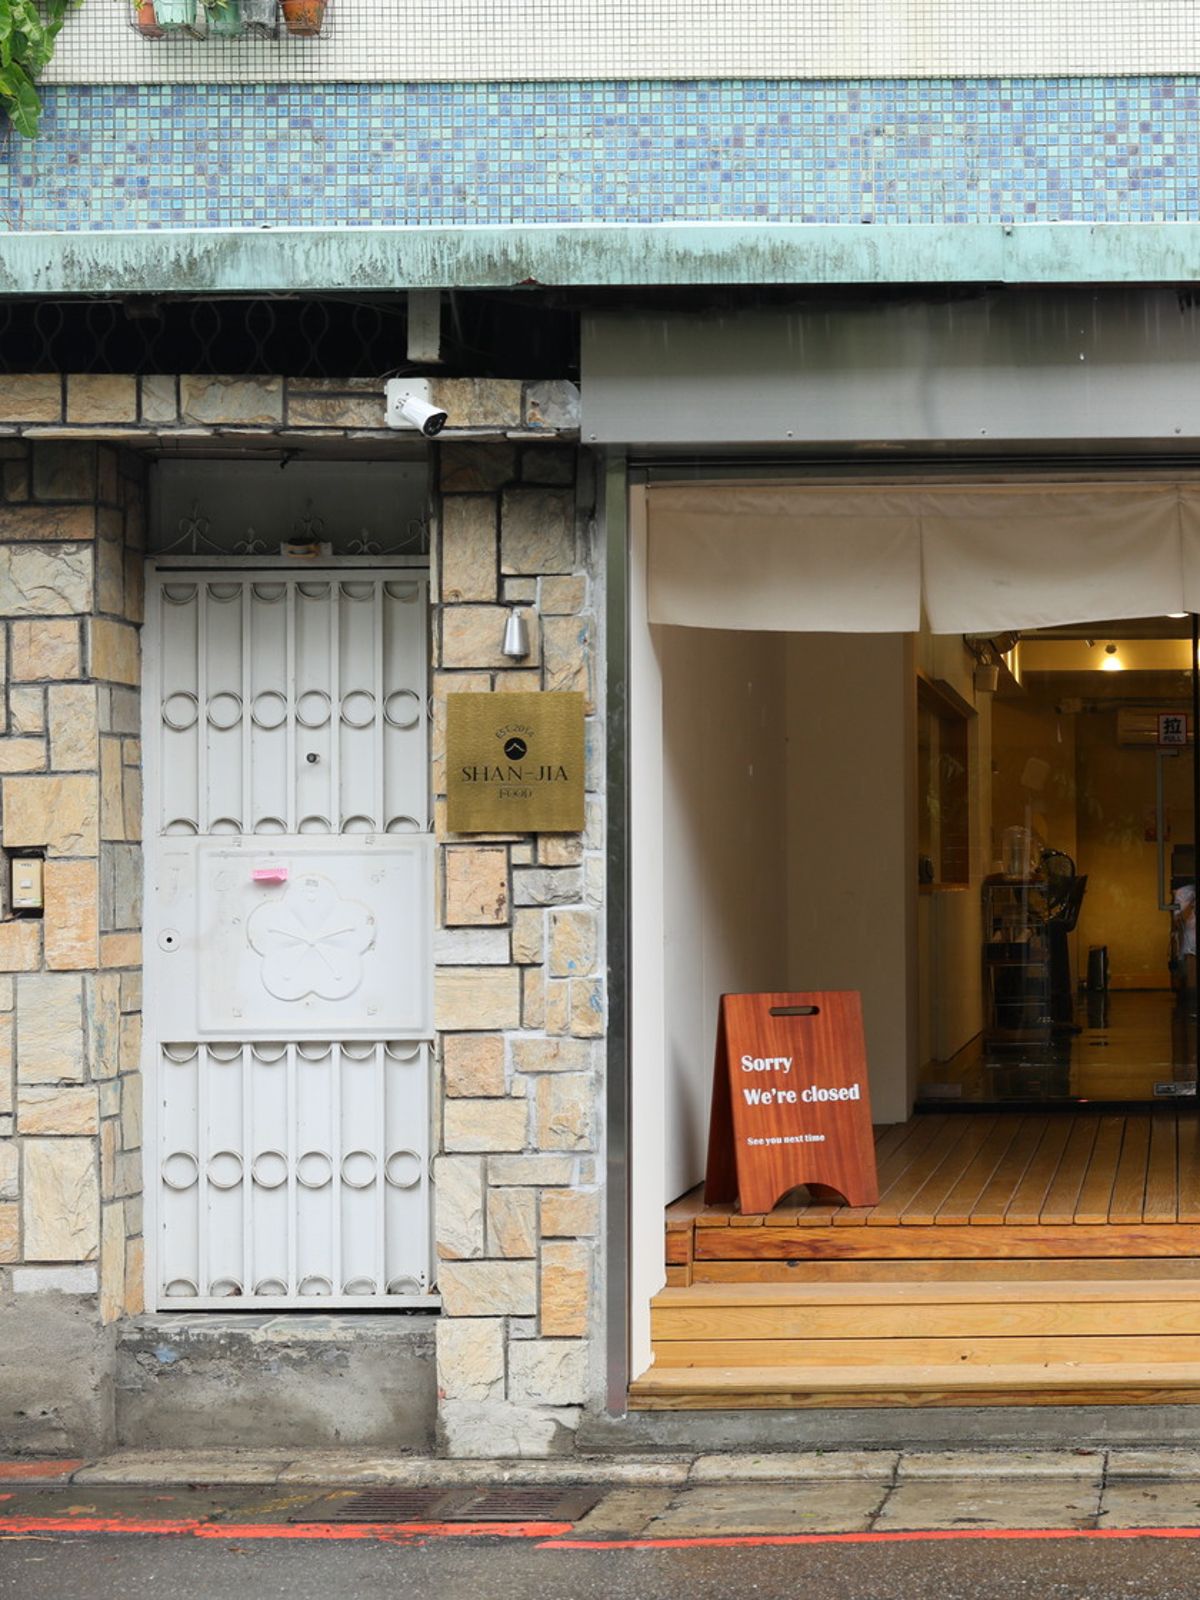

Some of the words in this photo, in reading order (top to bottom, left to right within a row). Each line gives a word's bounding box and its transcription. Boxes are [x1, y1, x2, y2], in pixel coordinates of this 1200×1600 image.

[1163, 717, 1182, 734] 拉
[461, 765, 568, 782] SHAN-JIA
[741, 1055, 793, 1074] Sorry
[743, 1088, 797, 1105] We're
[801, 1083, 860, 1103] closed
[747, 1137, 764, 1146] See
[765, 1136, 782, 1147] you
[783, 1134, 803, 1144] next
[804, 1132, 826, 1142] time
